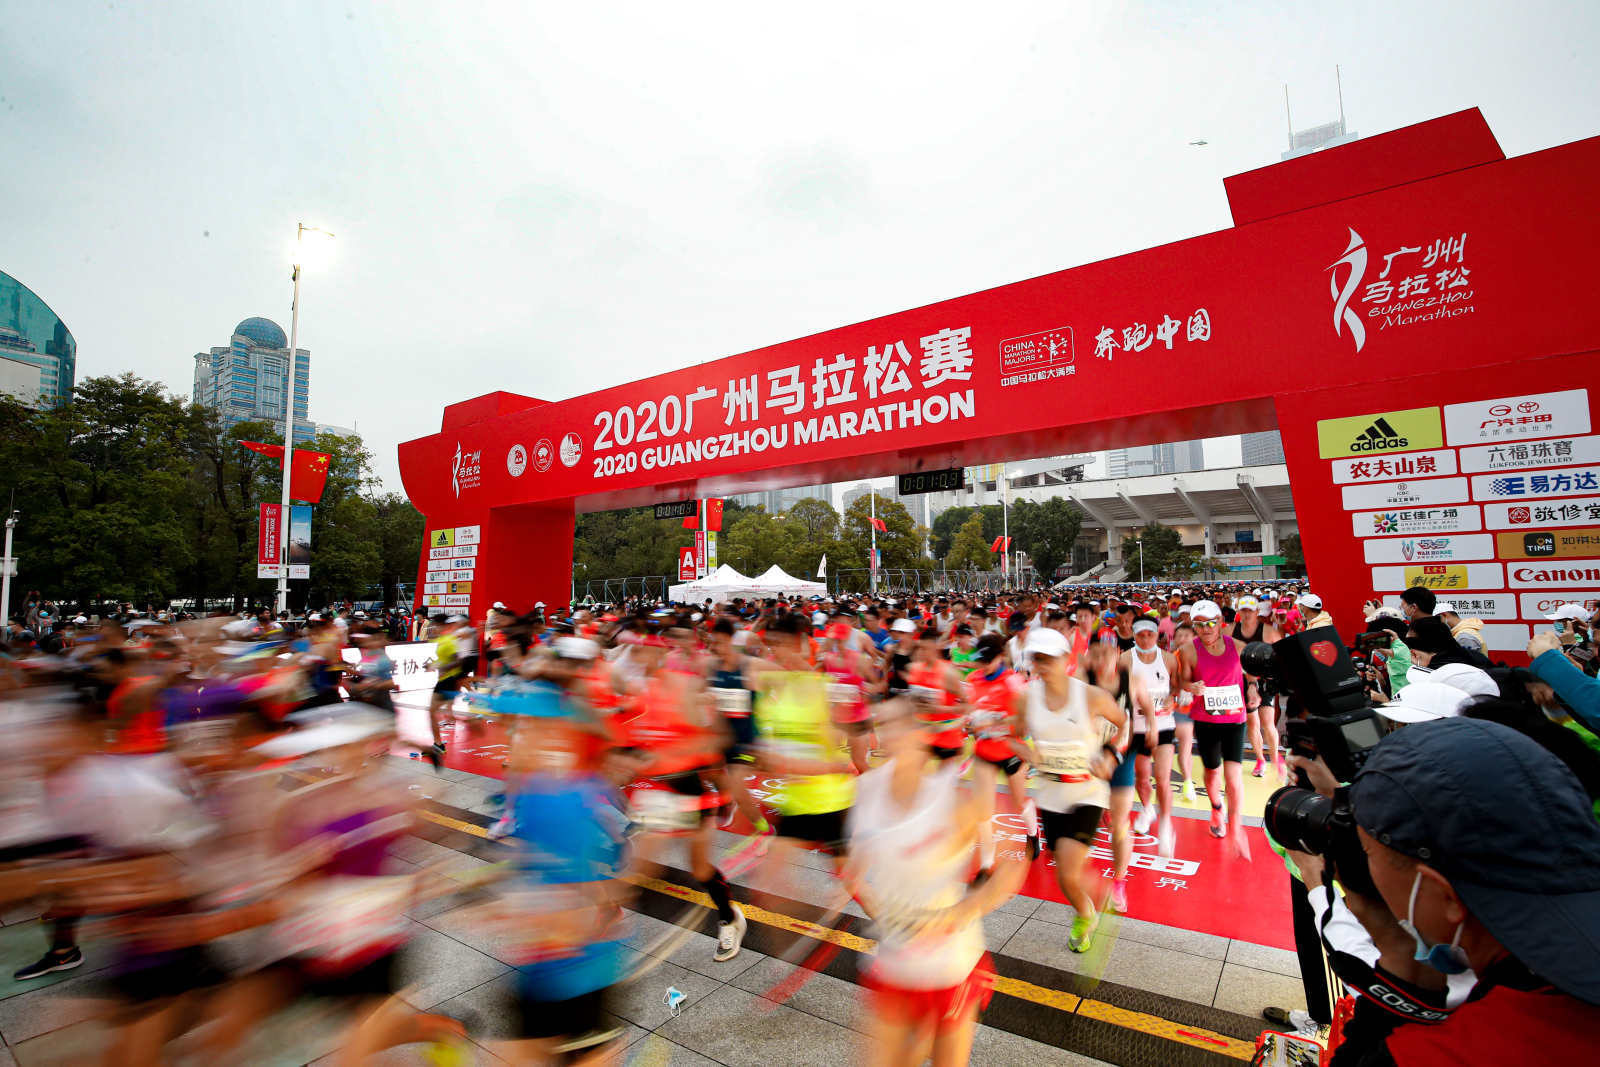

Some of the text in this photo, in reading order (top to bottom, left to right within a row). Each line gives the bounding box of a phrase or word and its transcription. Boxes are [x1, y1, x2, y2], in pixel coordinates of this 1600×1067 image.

[1379, 232, 1466, 279] 广州
[1361, 266, 1471, 304] 马拉松
[1368, 290, 1474, 317] GUANGZHOU
[1380, 305, 1475, 331] Marathon
[1094, 307, 1211, 361] 奔跑中国
[1004, 340, 1035, 353] CHINA
[1004, 348, 1035, 359] MARATHON
[1004, 354, 1036, 366] MAJORS
[593, 326, 974, 451] 2020广州马拉松赛
[1480, 413, 1552, 429] 广汽丰田
[593, 389, 975, 478] 2020 GUANGZHOU MARATHON
[1350, 437, 1408, 452] adidas
[1350, 456, 1437, 480] 农夫山泉
[1530, 471, 1599, 494] 易方达
[1400, 508, 1458, 520] 正佳广场
[1534, 502, 1600, 522] 敬修堂
[1527, 544, 1553, 552] TIME
[682, 551, 695, 568] A
[1513, 568, 1600, 582] Canon
[1207, 695, 1240, 707] B0459
[1369, 984, 1418, 1013] EOS
